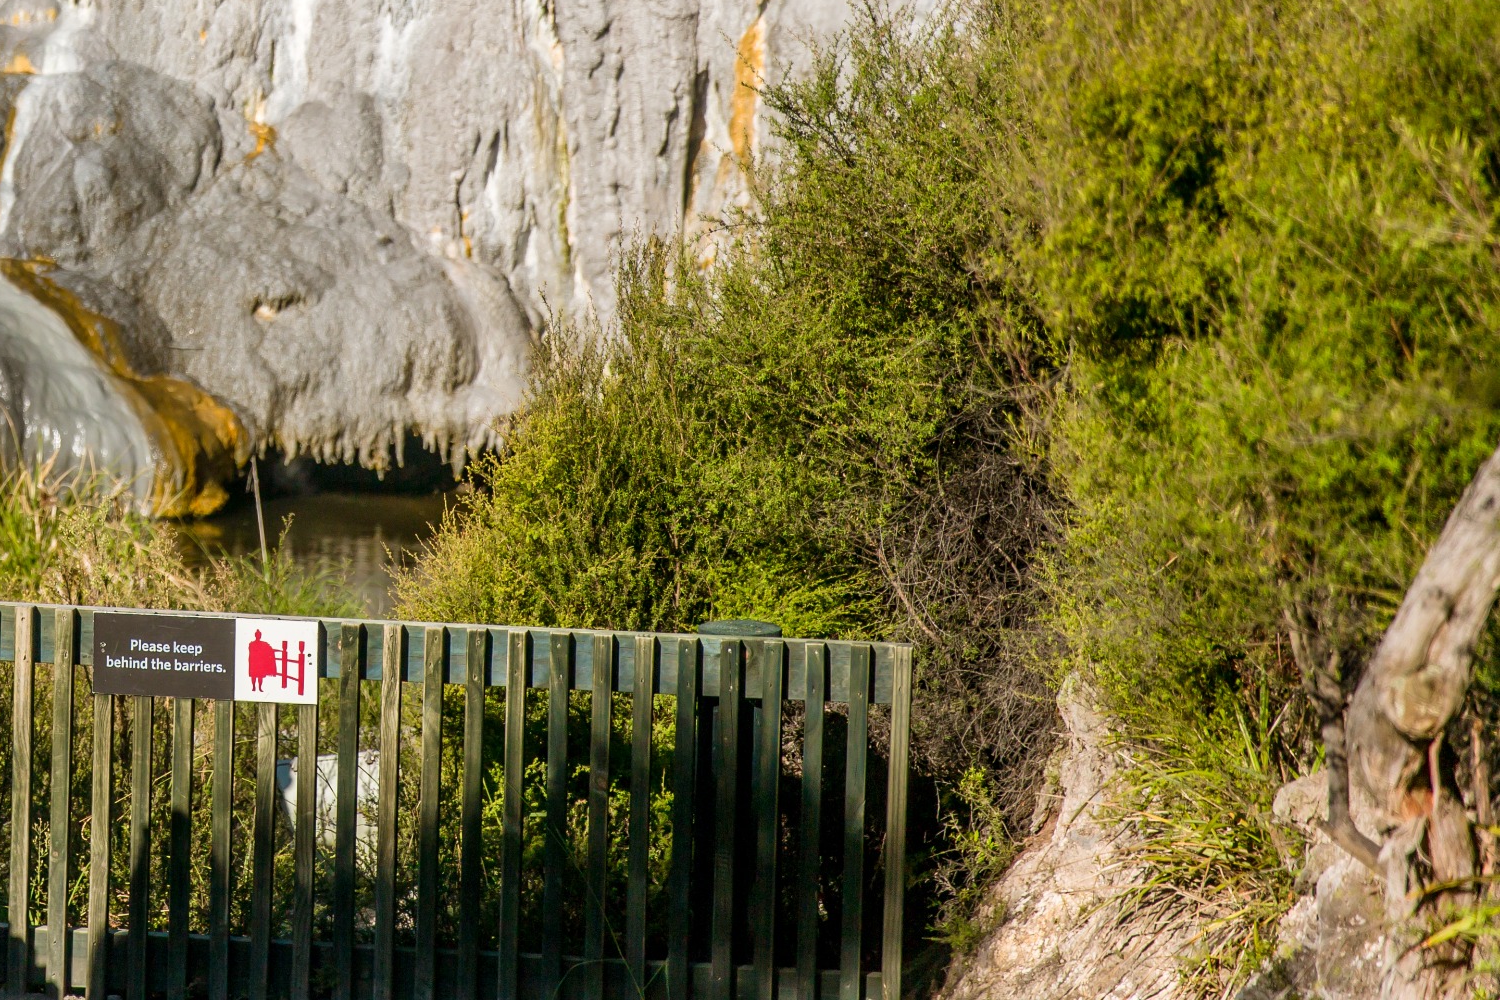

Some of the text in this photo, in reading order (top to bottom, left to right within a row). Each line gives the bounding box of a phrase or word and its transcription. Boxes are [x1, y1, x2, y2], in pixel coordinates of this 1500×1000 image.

[130, 639, 203, 656] Please keep
[106, 655, 227, 673] behind the barriers.
